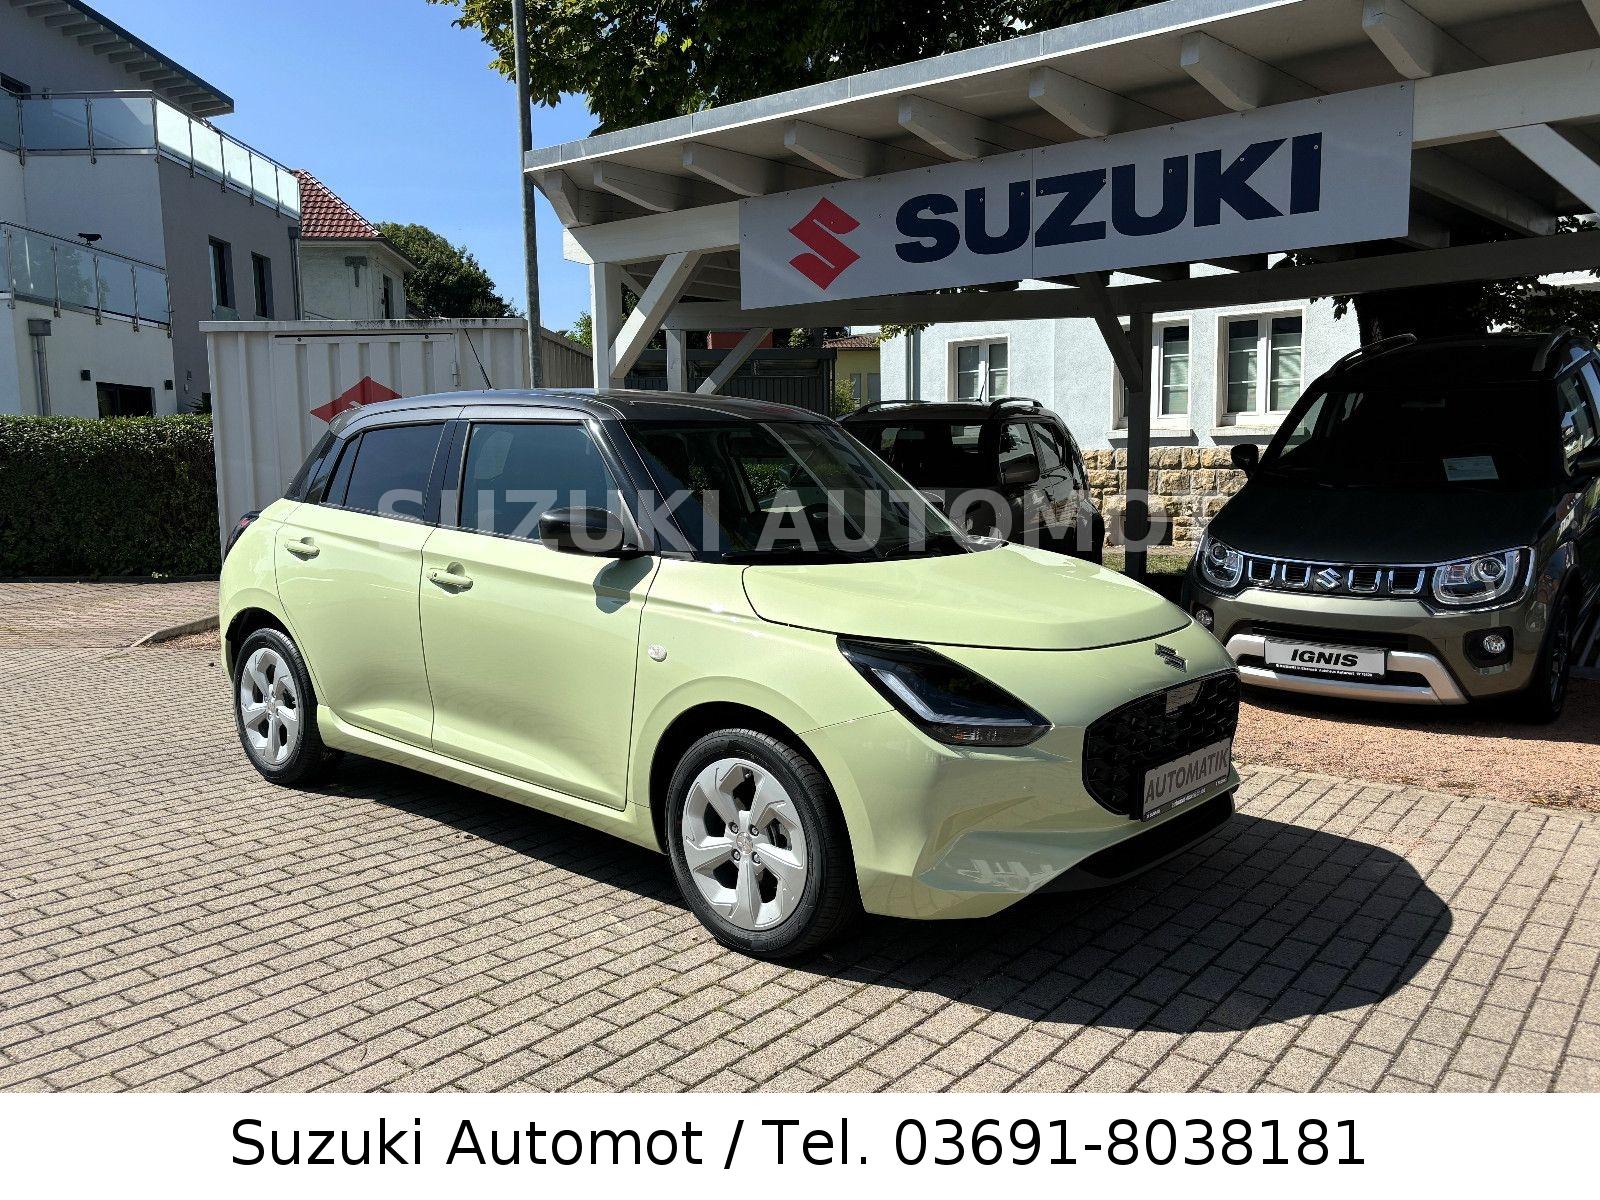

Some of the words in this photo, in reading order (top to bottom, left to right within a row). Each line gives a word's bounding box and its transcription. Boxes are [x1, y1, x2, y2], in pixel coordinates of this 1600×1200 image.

[895, 131, 1323, 263] SUZUKI
[1290, 648, 1359, 667] IGNIS
[1144, 747, 1229, 804] AUTOMATIK
